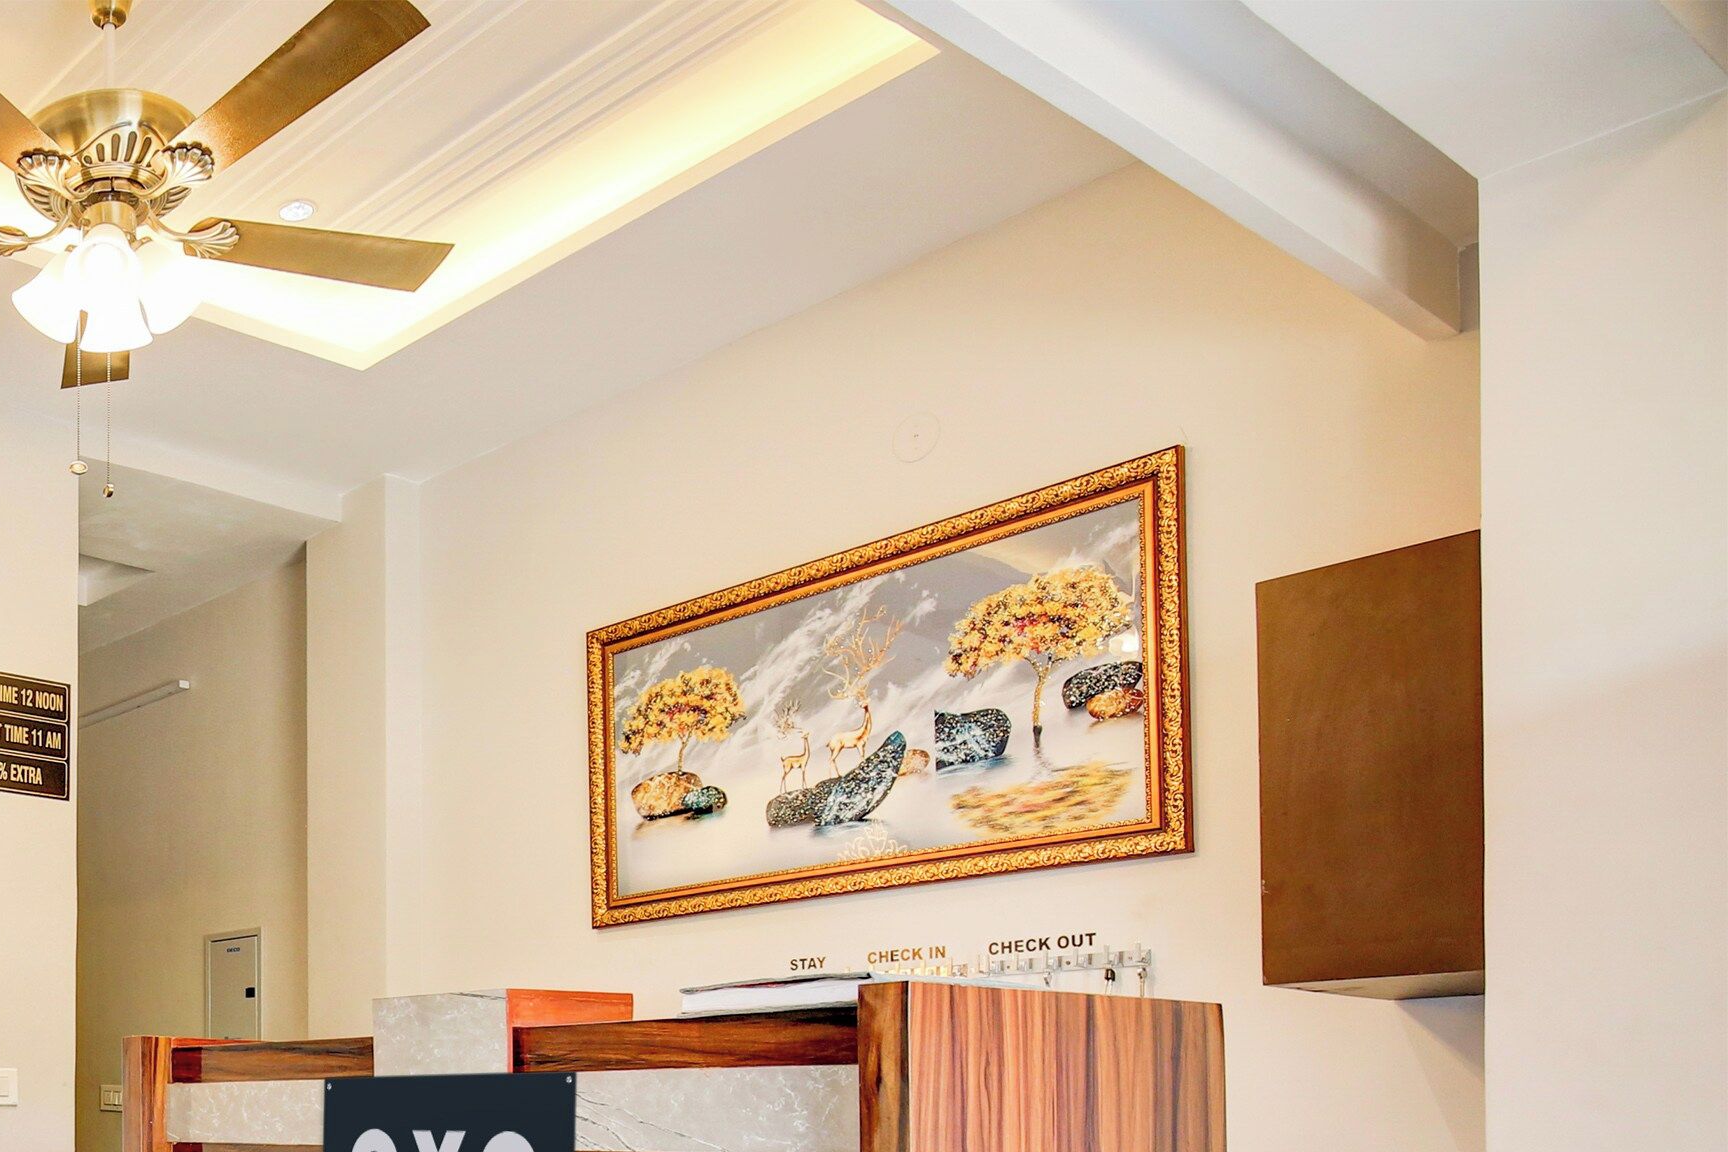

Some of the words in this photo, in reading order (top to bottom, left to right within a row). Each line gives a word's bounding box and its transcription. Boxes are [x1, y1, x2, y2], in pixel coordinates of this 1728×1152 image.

[21, 688, 33, 707] 12
[35, 691, 64, 712] NOON
[4, 724, 29, 745] TIME
[31, 728, 43, 747] 11
[45, 731, 62, 750] AM
[10, 763, 43, 785] EXTRA
[867, 947, 923, 965] CHECK
[928, 945, 947, 961] IN
[988, 937, 1051, 956] CHECK
[1057, 932, 1097, 949] OUT
[790, 957, 826, 971] STAY
